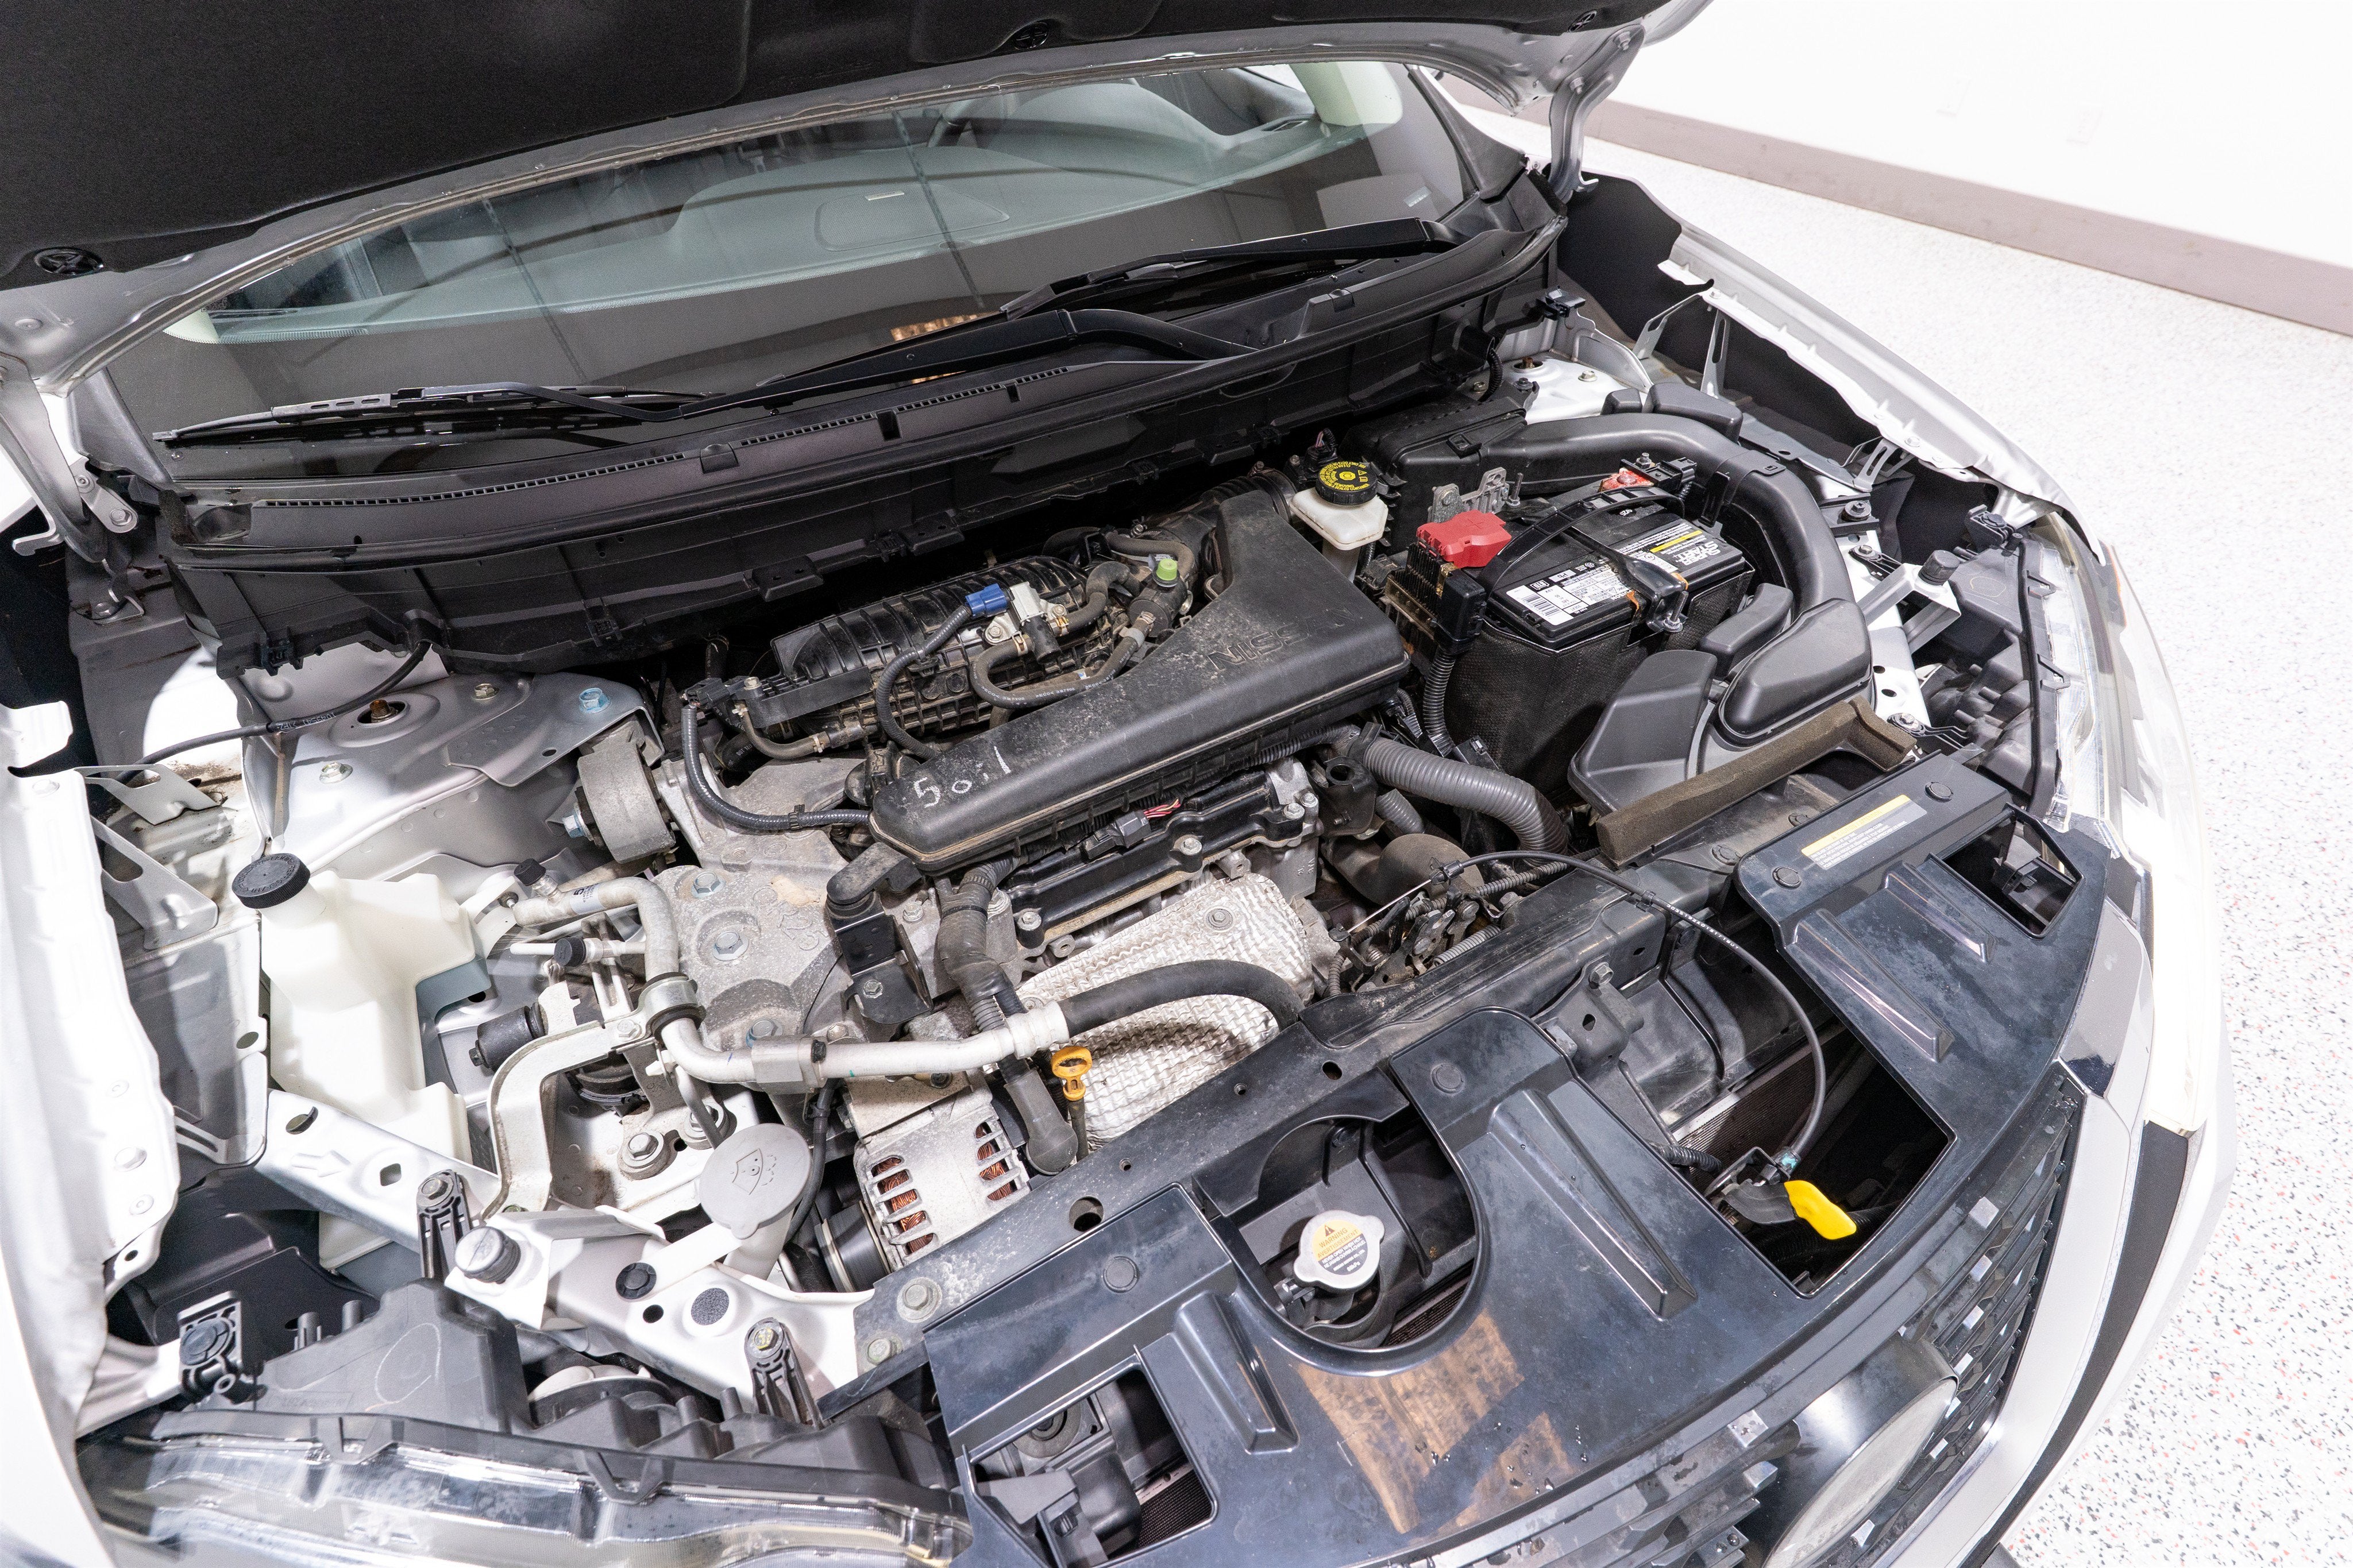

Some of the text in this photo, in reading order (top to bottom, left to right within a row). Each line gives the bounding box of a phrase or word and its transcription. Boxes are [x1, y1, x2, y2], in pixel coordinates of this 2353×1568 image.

[1676, 540, 1719, 562] START
[1681, 548, 1721, 565] SUPER
[1207, 608, 1355, 671] NISSAN
[1318, 1227, 1348, 1248] WARNING
[1318, 1229, 1357, 1258] AVERTISSEMENT
[1321, 1254, 1334, 1264] NEVER
[1332, 1248, 1344, 1257] OPEN
[1342, 1241, 1355, 1250] WHEN
